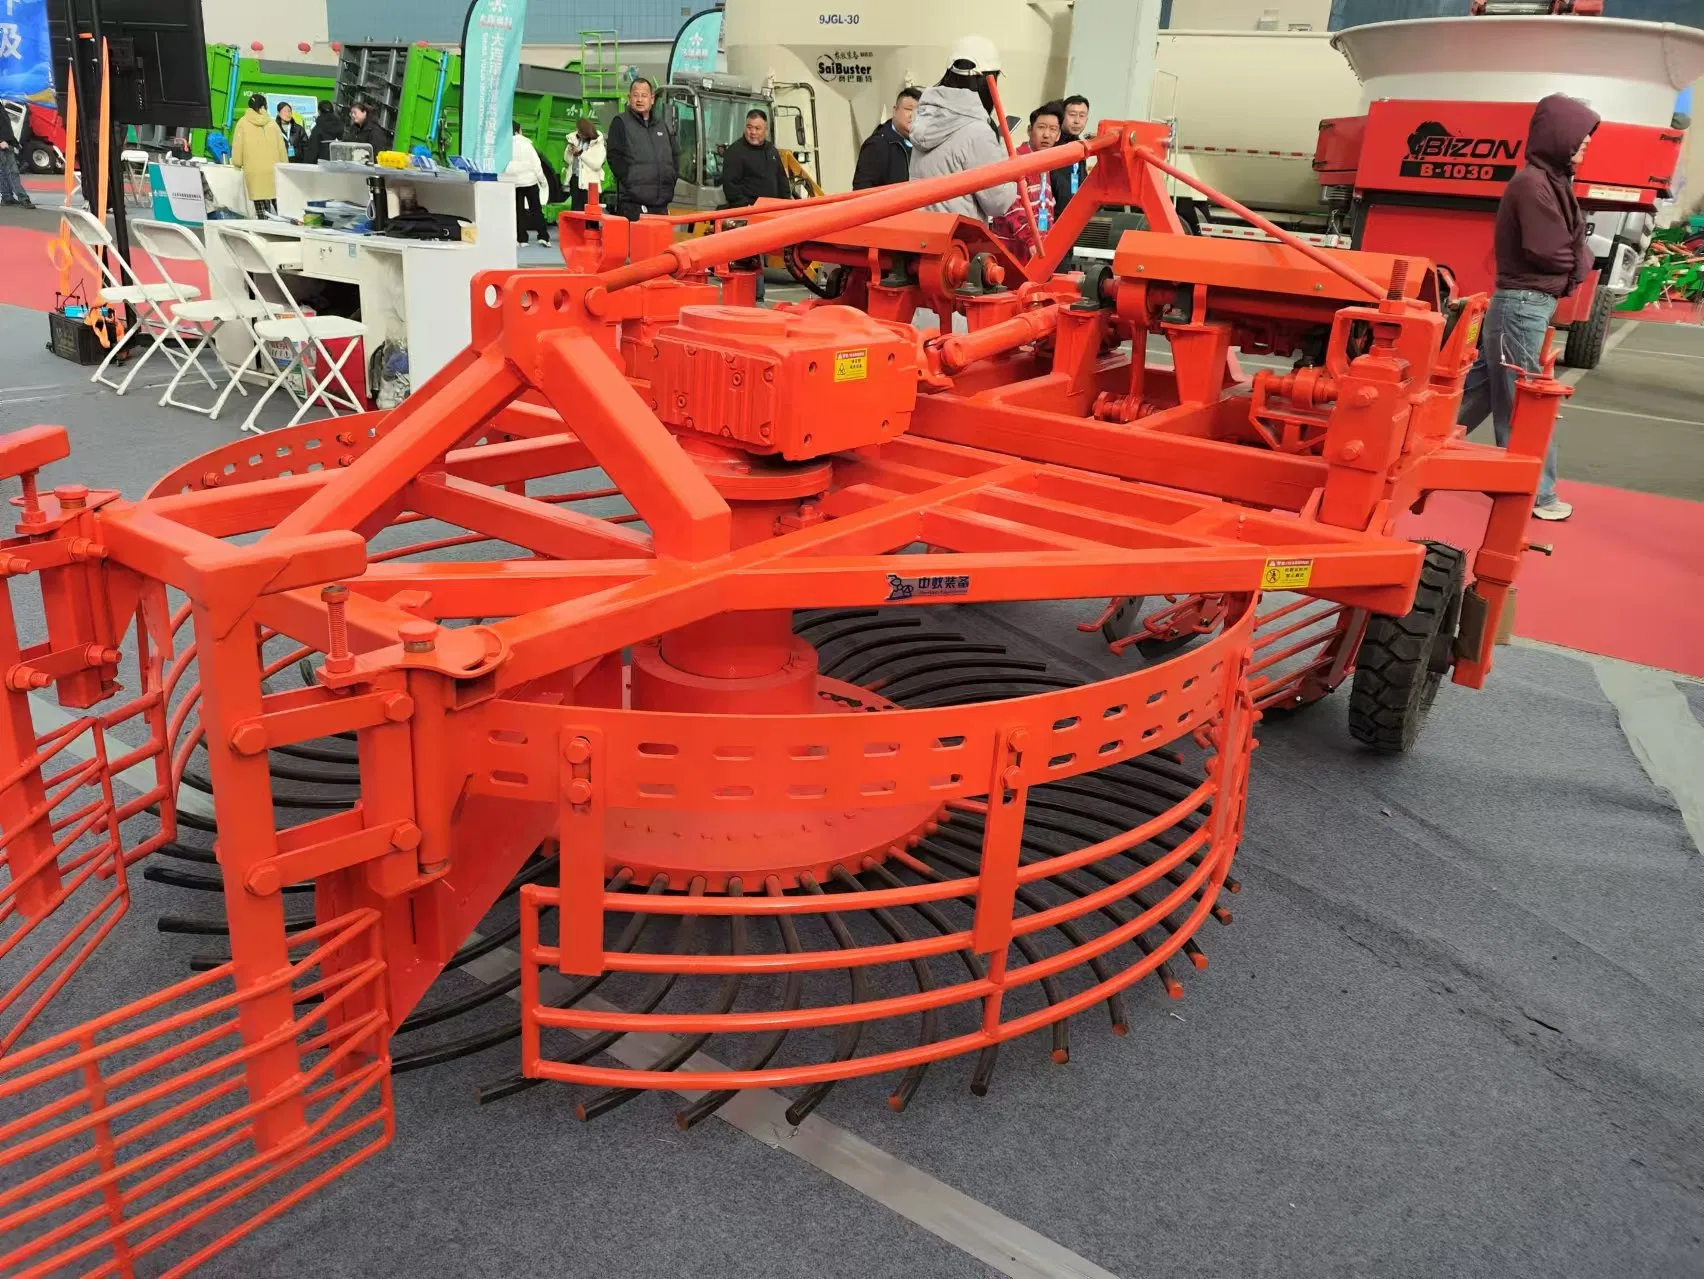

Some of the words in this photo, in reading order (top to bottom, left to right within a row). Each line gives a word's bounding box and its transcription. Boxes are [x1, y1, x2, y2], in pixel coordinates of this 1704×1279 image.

[819, 14, 860, 25] 9JGL-30
[818, 61, 872, 75] SaiBuster
[1420, 136, 1522, 160] BIZON
[1420, 163, 1494, 180] B-1030
